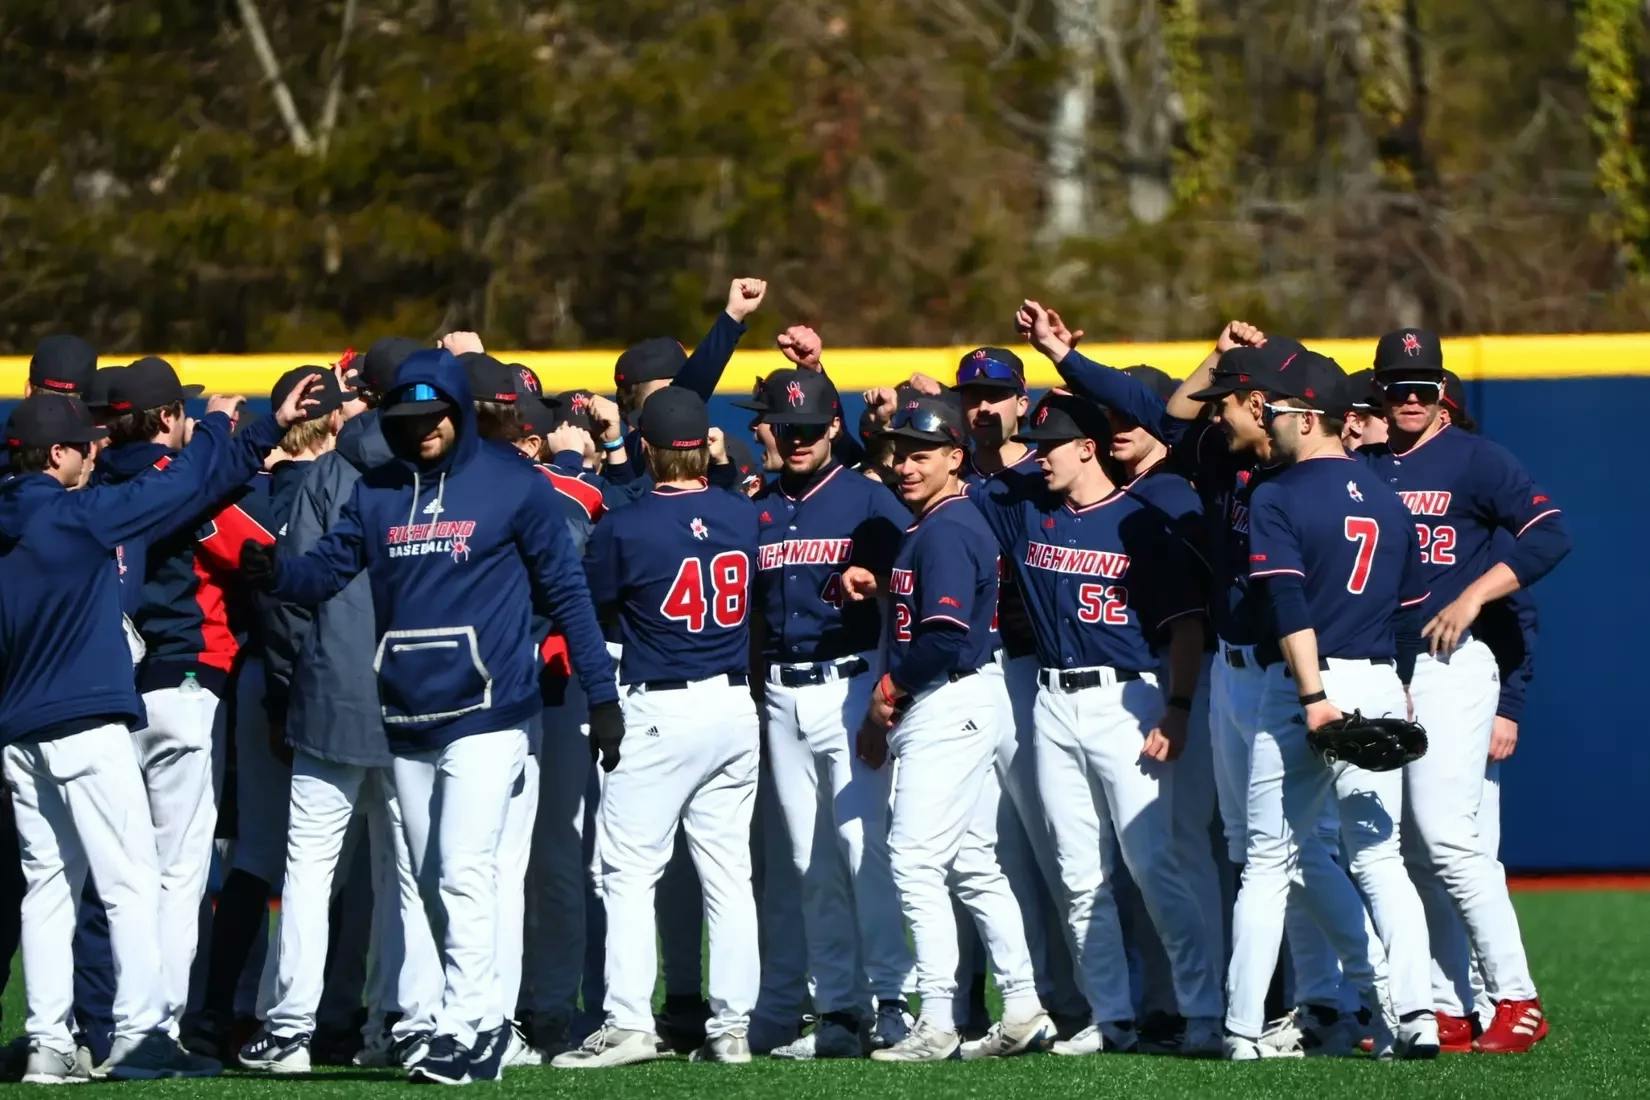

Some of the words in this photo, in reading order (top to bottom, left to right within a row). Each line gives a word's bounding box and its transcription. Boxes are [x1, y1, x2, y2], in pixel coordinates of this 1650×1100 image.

[1398, 491, 1452, 516] OND
[389, 540, 451, 557] BASEBALL
[757, 539, 853, 571] ICHMOND
[1024, 541, 1131, 579] RICHMOND
[1345, 516, 1379, 594] 7
[1415, 523, 1456, 565] 22
[660, 550, 749, 633] 48
[1078, 583, 1128, 625] 52
[896, 603, 911, 642] 2
